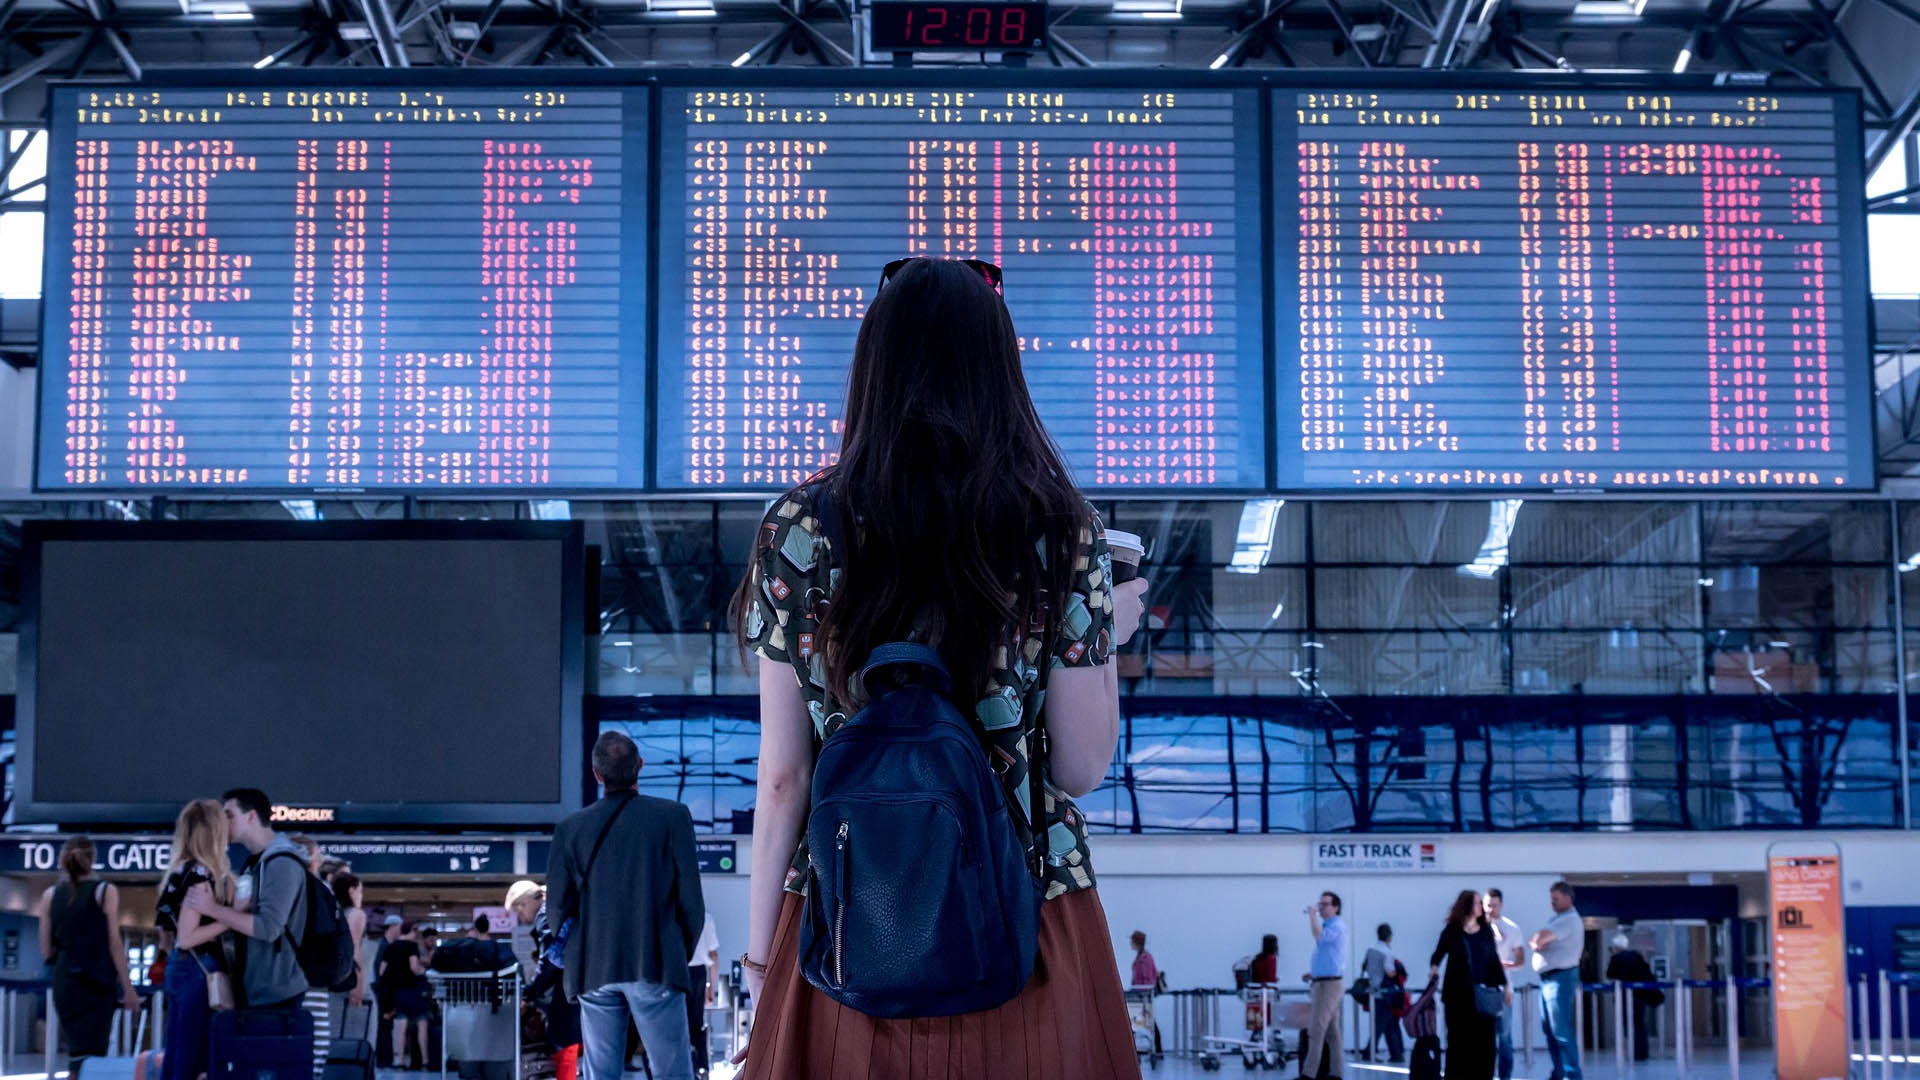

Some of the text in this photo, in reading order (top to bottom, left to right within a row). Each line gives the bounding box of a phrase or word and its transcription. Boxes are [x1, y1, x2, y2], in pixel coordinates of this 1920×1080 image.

[905, 8, 1026, 44] 12:08
[18, 843, 55, 869] TO
[327, 844, 348, 853] YOUR
[349, 844, 387, 853] PASSPORT
[388, 844, 404, 853] AND
[405, 844, 443, 853] BOARDING
[444, 844, 463, 853] PASS
[463, 844, 490, 853] READY
[1319, 844, 1412, 857] FAST TRACK
